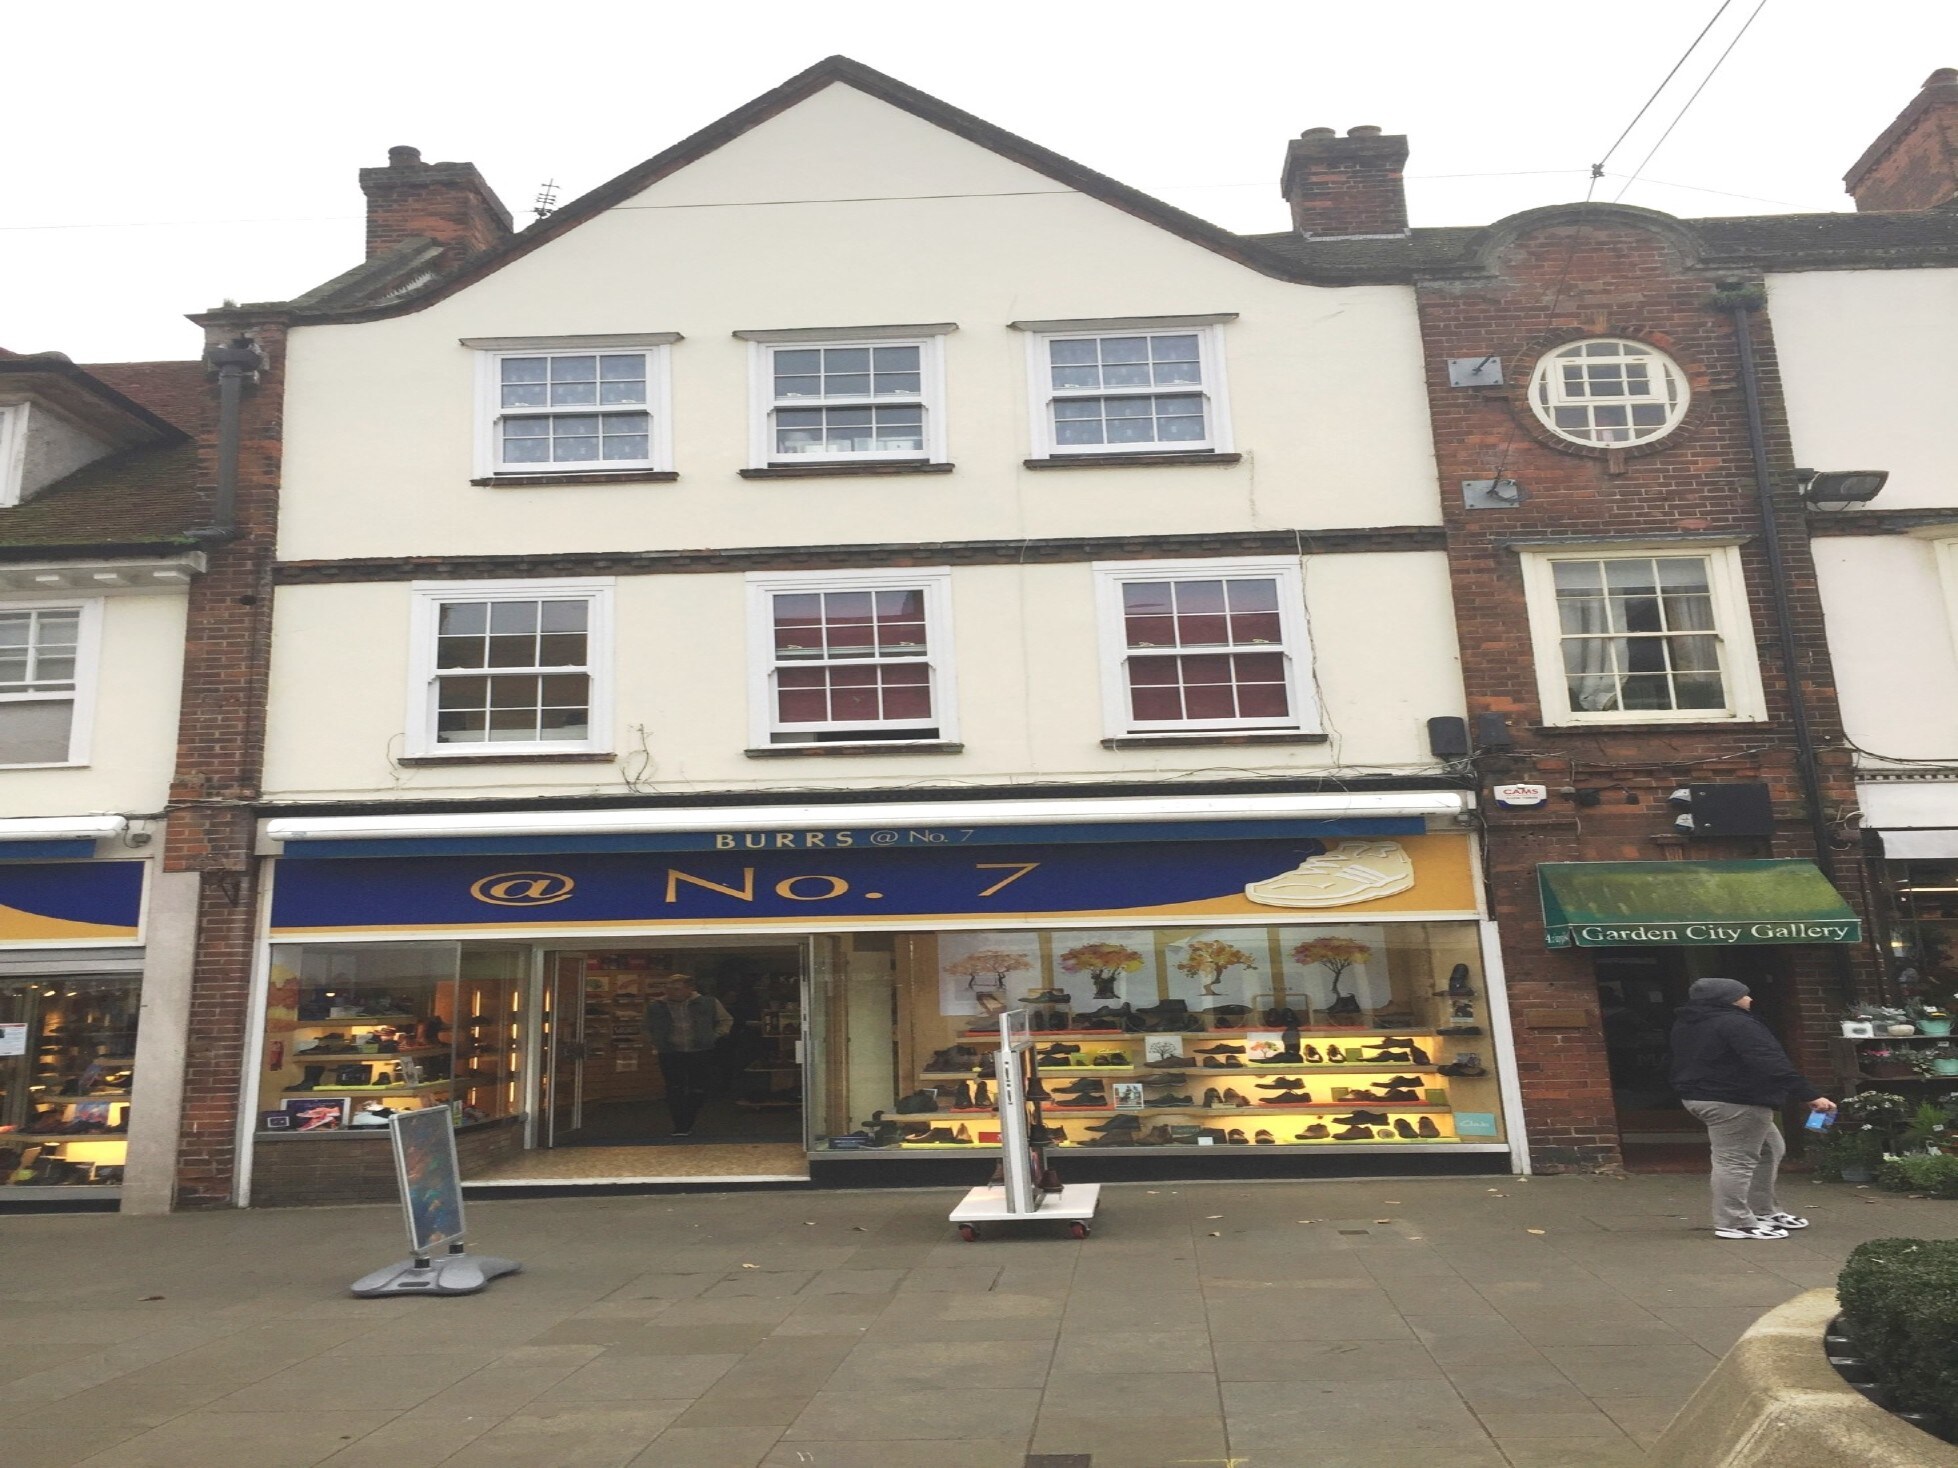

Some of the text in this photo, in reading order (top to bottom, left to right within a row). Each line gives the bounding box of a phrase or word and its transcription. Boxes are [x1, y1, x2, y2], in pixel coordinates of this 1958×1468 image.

[715, 829, 975, 849] BURRS @ No. 7
[470, 862, 1041, 906] @ No. 7
[1581, 926, 1679, 942] Garden
[1686, 925, 1742, 943] City
[1750, 922, 1850, 940] Gallery
